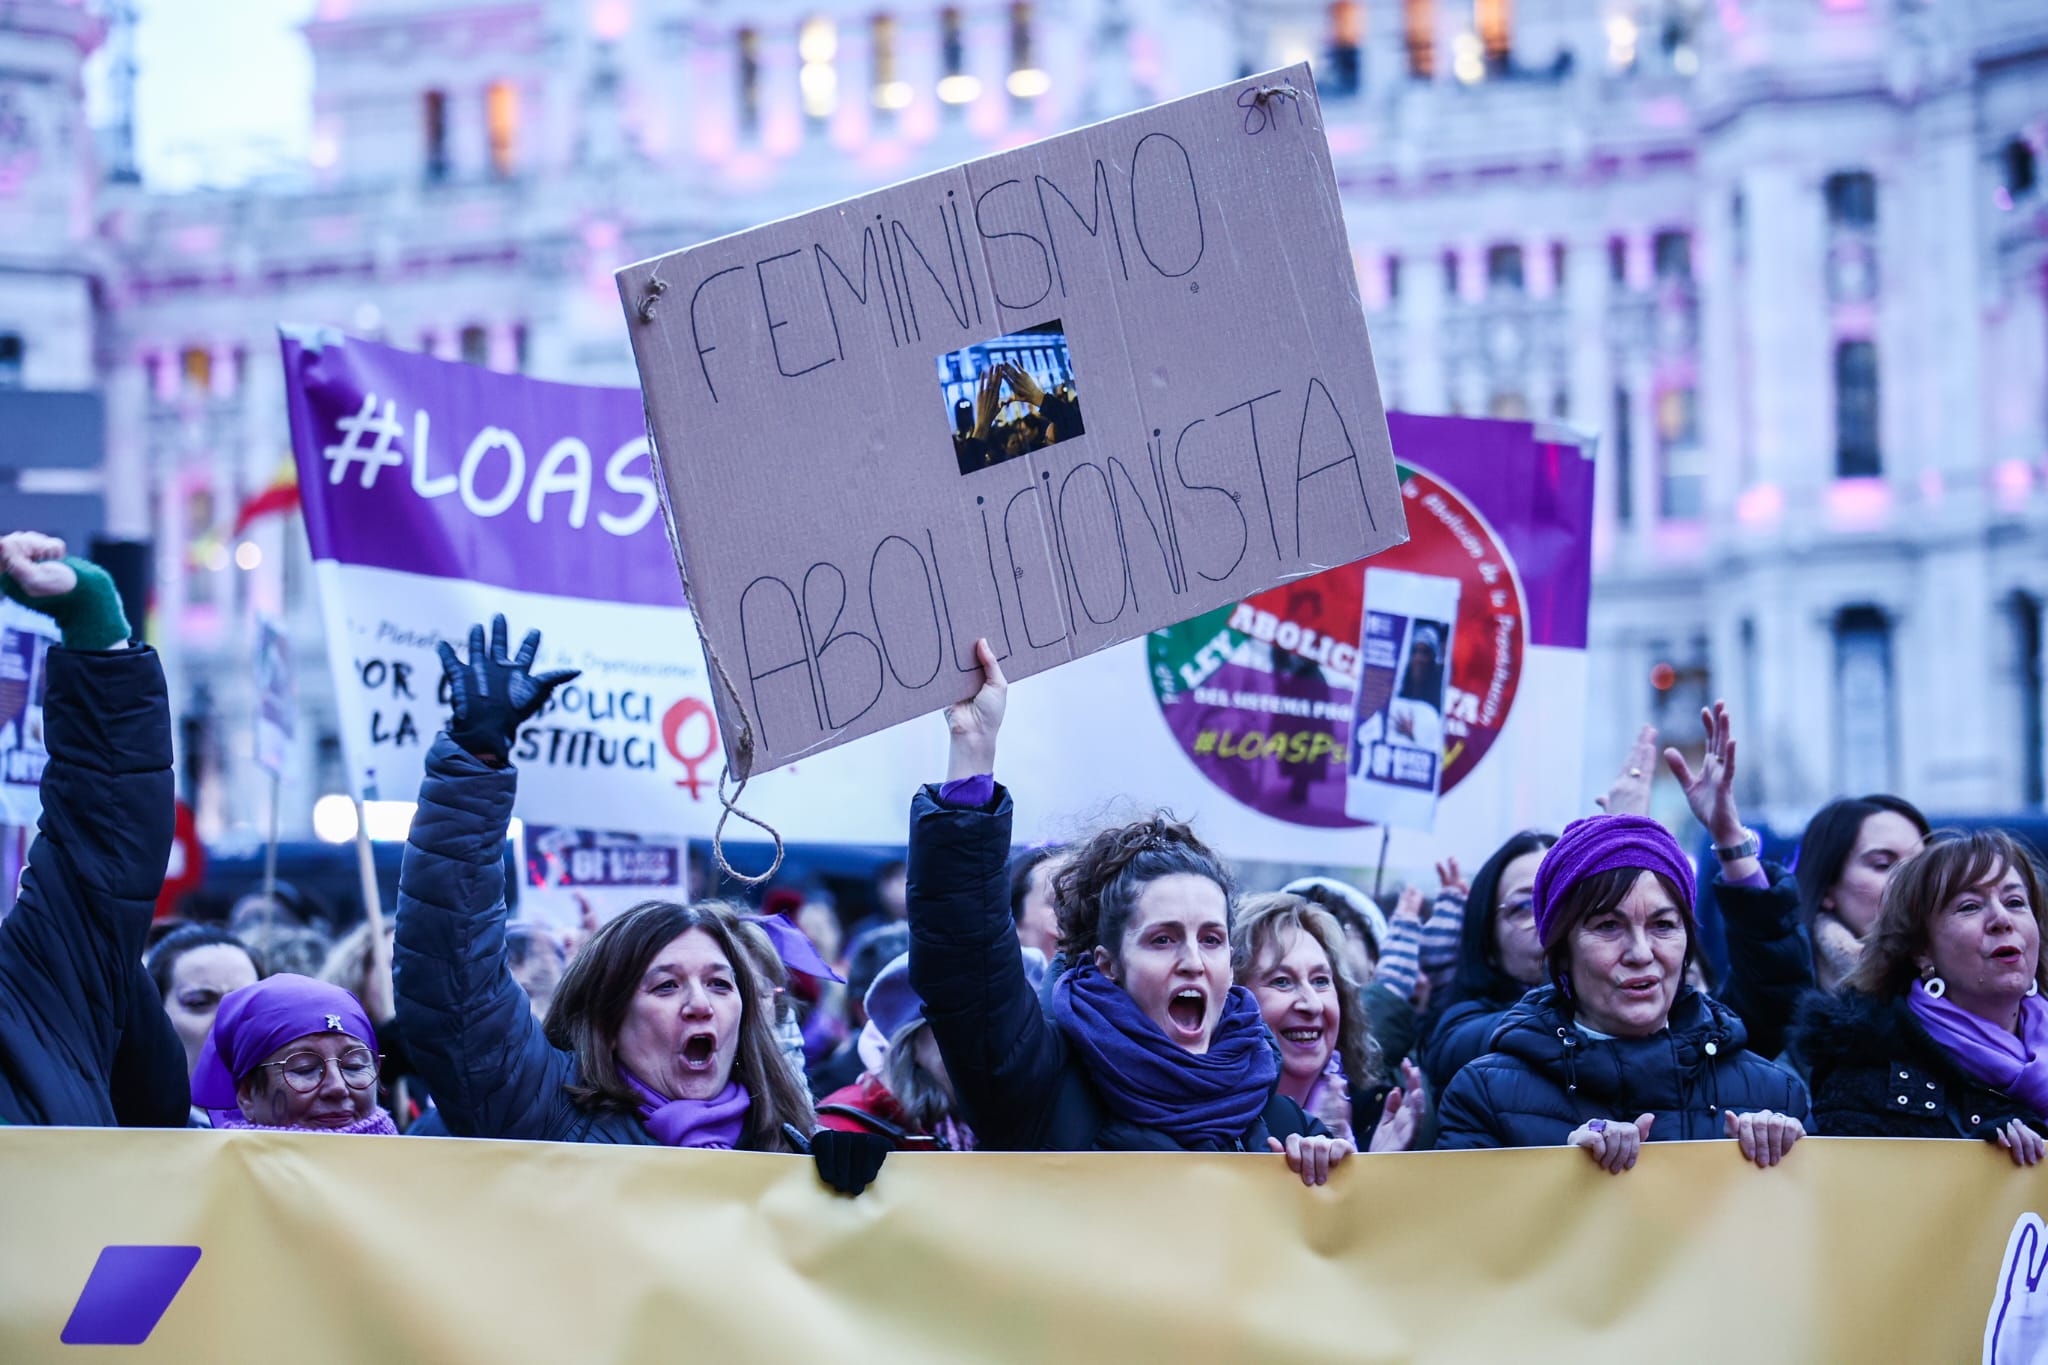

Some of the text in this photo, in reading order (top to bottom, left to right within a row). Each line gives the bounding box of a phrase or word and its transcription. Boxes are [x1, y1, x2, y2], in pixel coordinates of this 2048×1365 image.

[1237, 77, 1303, 135] 8M
[690, 132, 1205, 403] FEMINISMO
[740, 378, 1377, 751] ABOLICIONISTA
[355, 657, 417, 701] OR
[372, 709, 418, 746] LA
